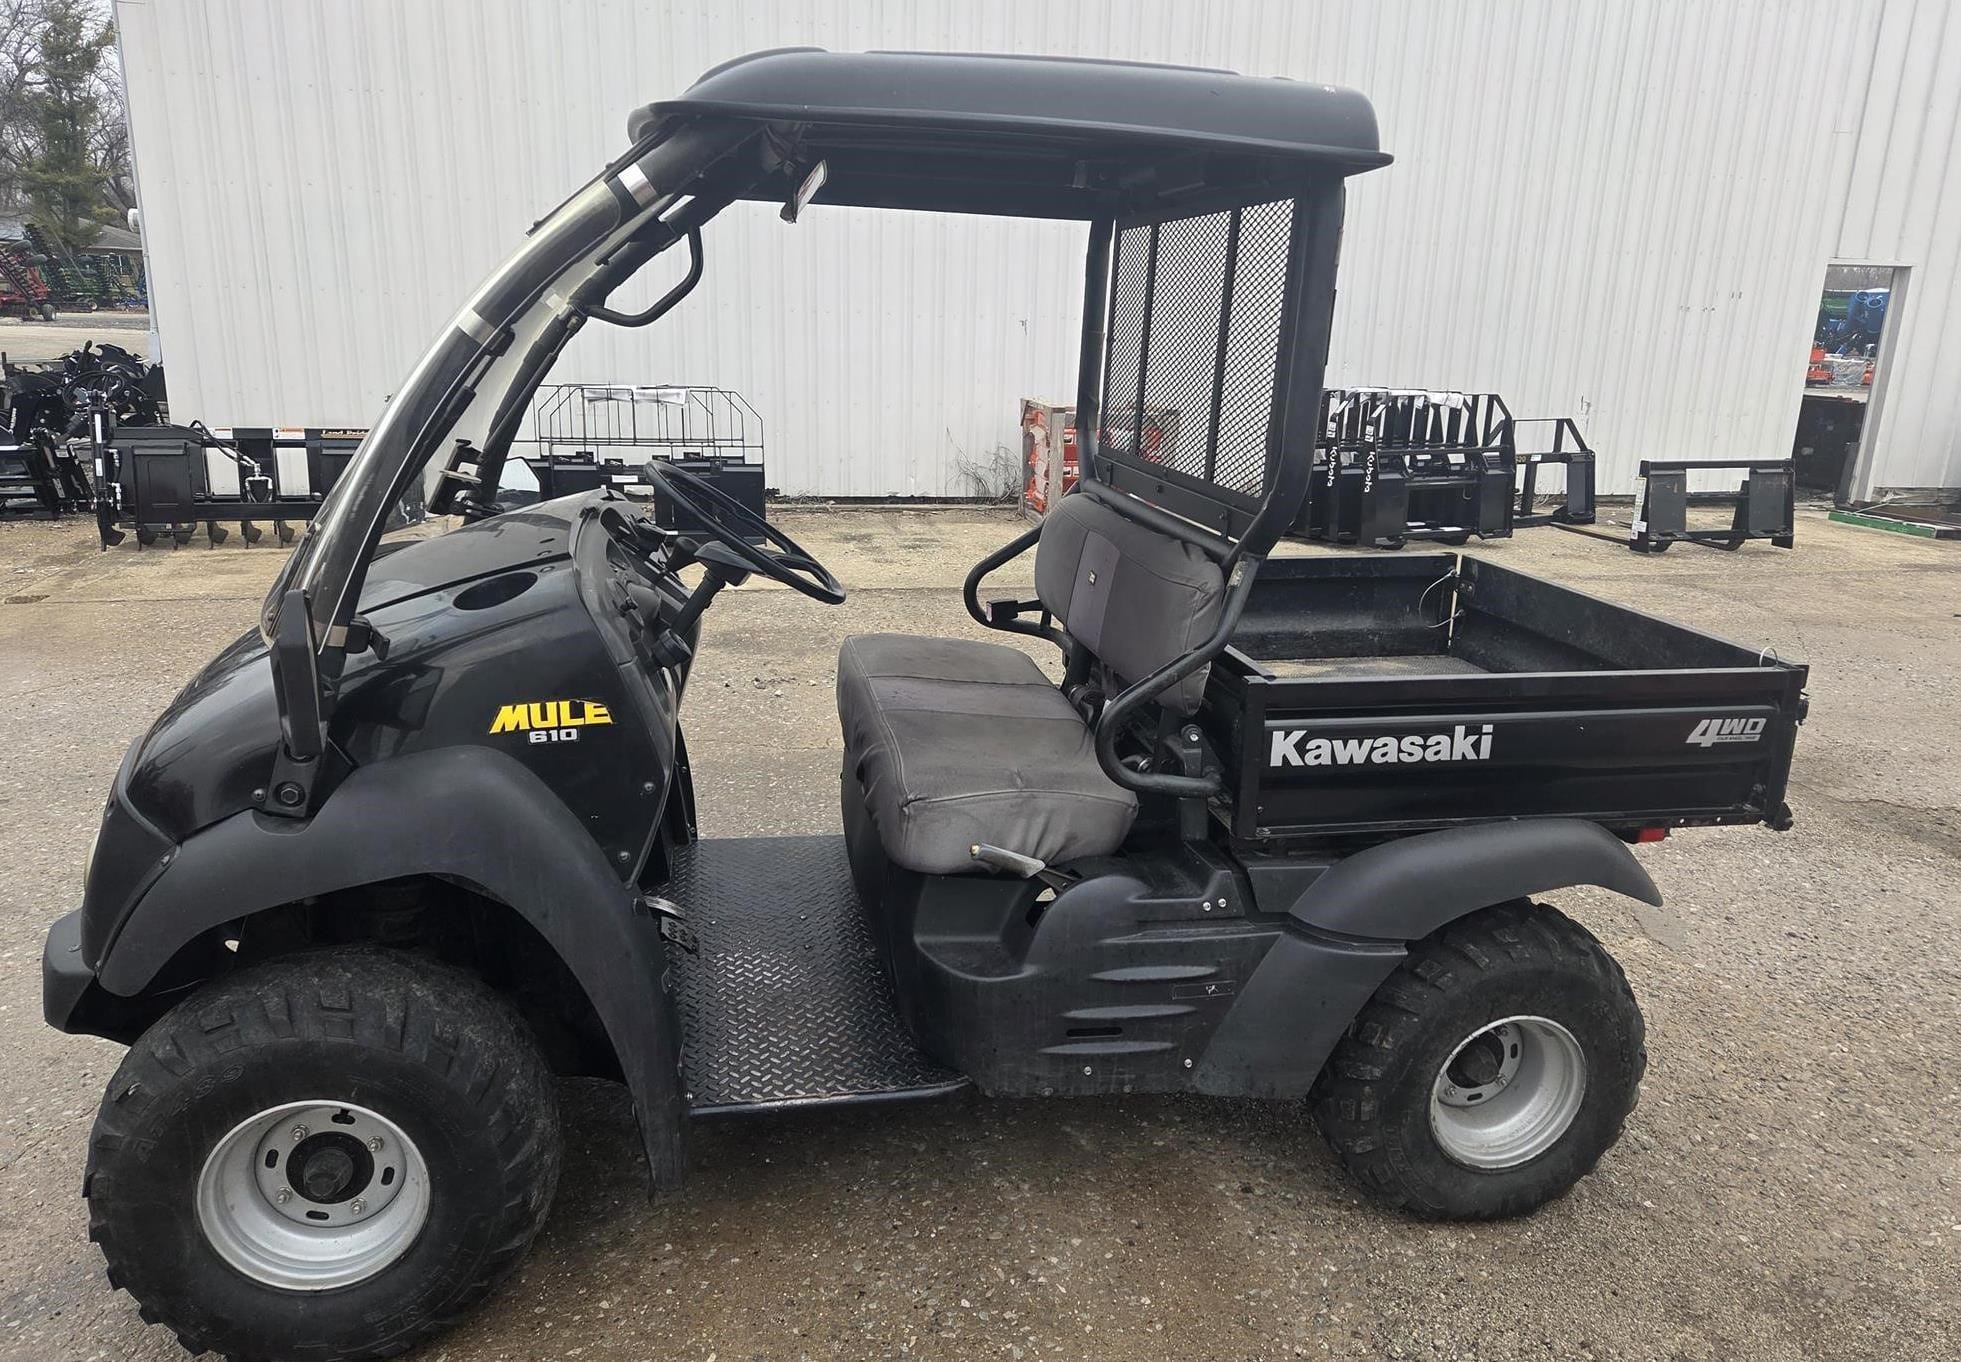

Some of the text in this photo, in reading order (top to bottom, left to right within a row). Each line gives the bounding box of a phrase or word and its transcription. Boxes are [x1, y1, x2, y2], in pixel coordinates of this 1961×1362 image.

[1326, 446, 1338, 487] Kubota
[1364, 451, 1376, 493] Kubota
[489, 699, 613, 734] MULE
[529, 728, 578, 743] 610
[1685, 717, 1767, 747] 4WD
[1269, 724, 1494, 767] Kawasaki
